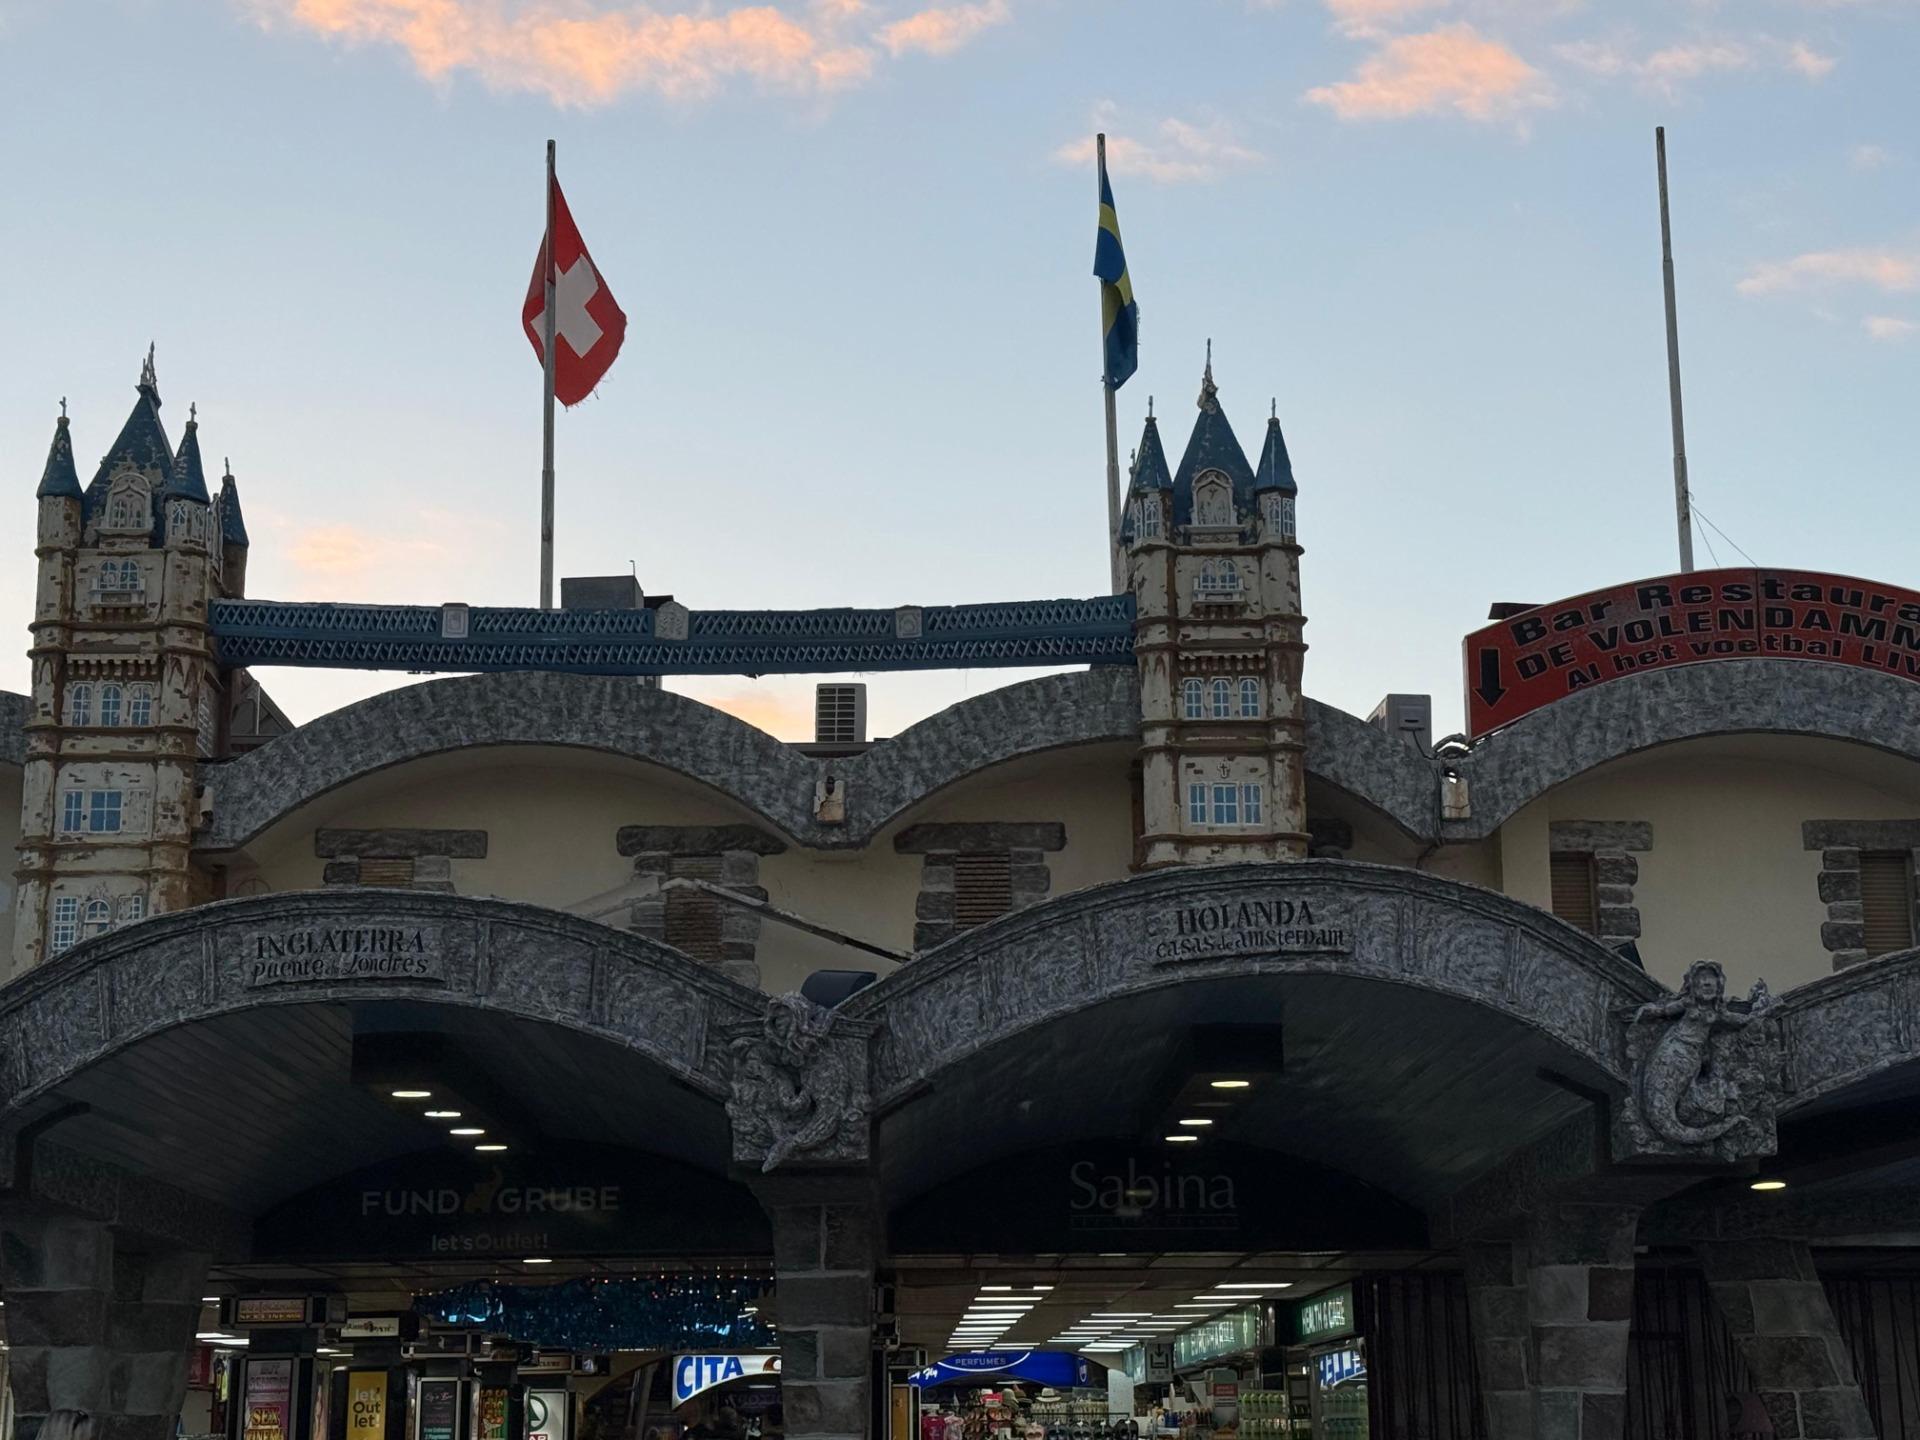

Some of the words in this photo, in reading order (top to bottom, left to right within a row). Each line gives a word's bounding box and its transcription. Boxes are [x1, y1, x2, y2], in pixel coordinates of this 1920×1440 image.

[1511, 600, 1613, 647] Bar
[1515, 641, 1577, 681] DE
[1567, 662, 1601, 691] Al
[1612, 643, 1678, 673] het
[1688, 633, 1841, 659] voetbal
[1176, 900, 1314, 935] HOLANDA
[256, 929, 424, 960] INGLATERRA
[1218, 936, 1234, 951] de
[361, 1190, 461, 1216] FUND
[497, 1186, 620, 1212] GRUBE
[1070, 1157, 1239, 1210] Sabina
[676, 1356, 744, 1400] CITA
[955, 1358, 1007, 1366] PERFUMES
[353, 1401, 381, 1414] Out
